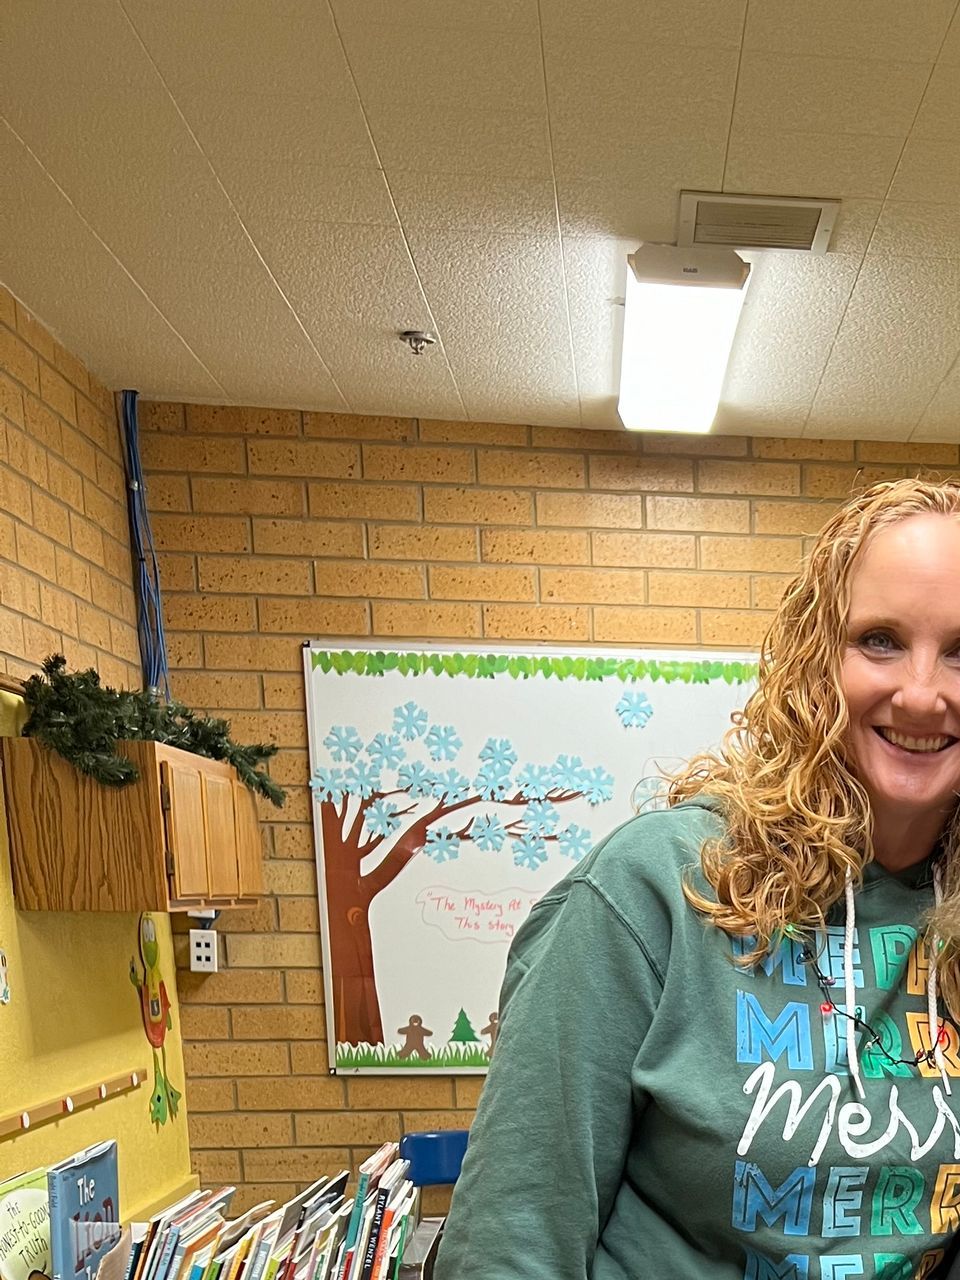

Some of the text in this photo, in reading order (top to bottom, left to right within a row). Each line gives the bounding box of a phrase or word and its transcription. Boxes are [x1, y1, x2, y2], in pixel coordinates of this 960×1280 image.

[464, 897, 503, 917] Mystery
[455, 917, 481, 930] This
[77, 1174, 96, 1206] The
[374, 1194, 385, 1225] RYLANT
[251, 1250, 267, 1278] Willems
[365, 1236, 377, 1270] WENZEL
